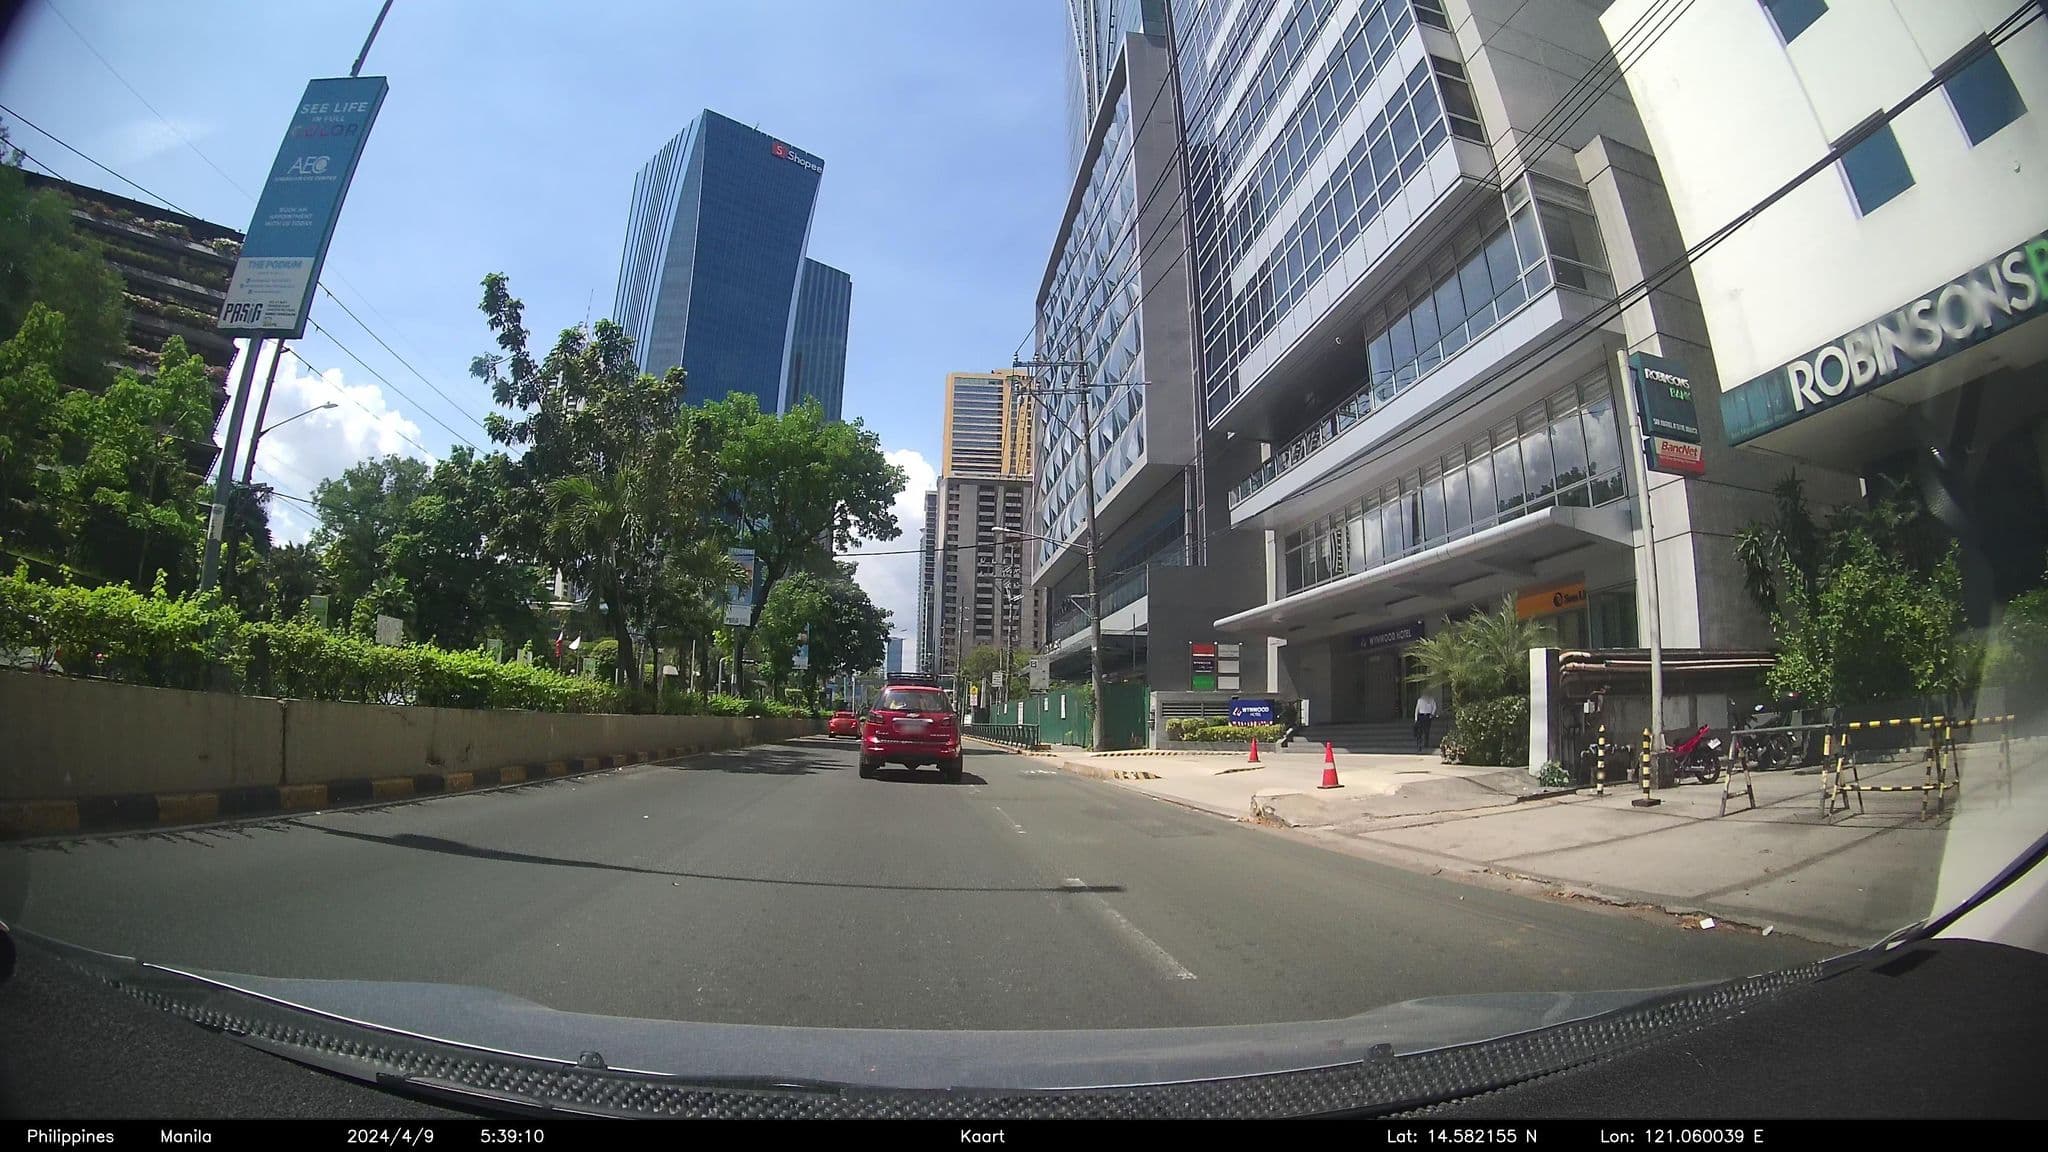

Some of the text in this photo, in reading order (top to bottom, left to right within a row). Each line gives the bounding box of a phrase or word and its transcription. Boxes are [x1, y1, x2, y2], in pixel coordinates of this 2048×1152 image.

[301, 102, 369, 114] SEE LIFE
[288, 155, 331, 174] AEC
[788, 150, 823, 173] Shopee
[1786, 251, 2038, 412] ROBINSONS
[1644, 367, 1690, 389] ROBINSONS
[1669, 387, 1692, 402] BANK
[1661, 441, 1698, 458] BancNet
